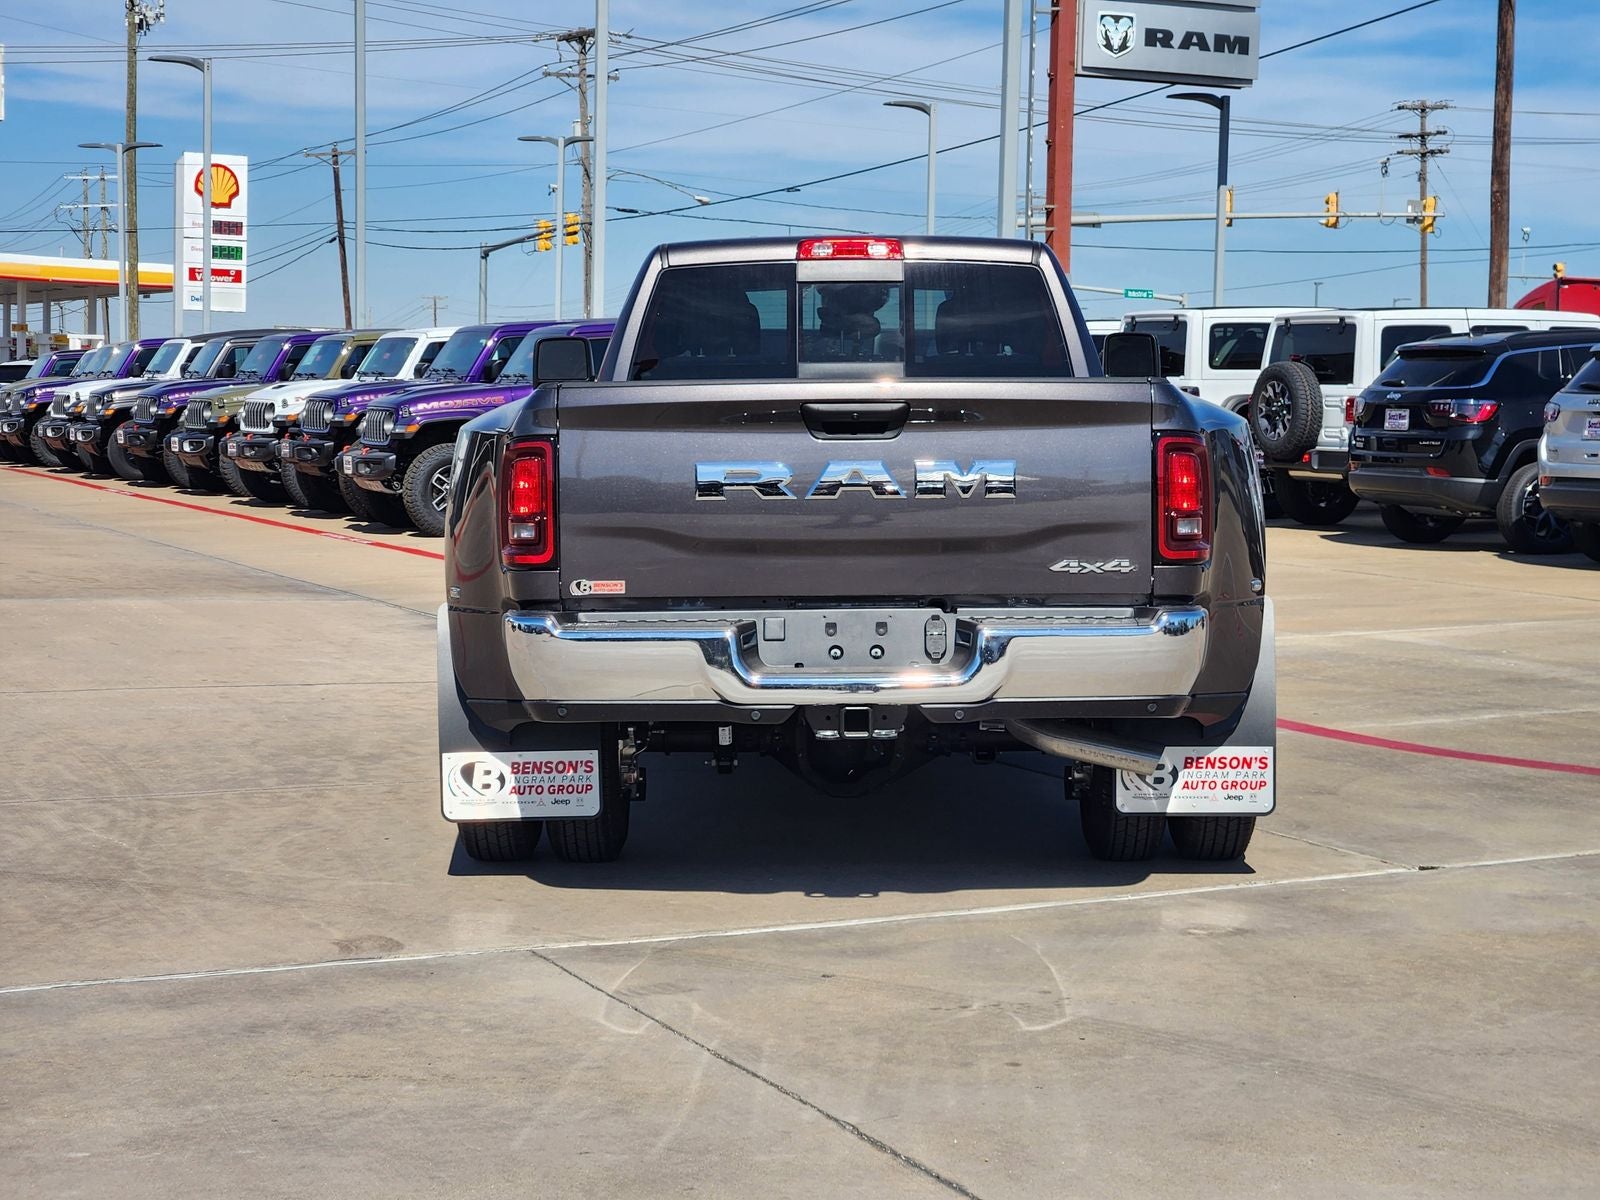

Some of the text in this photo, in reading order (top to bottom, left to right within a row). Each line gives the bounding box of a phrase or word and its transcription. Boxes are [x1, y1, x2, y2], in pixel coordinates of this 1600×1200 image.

[1144, 27, 1250, 56] RAM
[416, 396, 506, 410] MOJAVE
[694, 459, 1017, 501] RAM
[1048, 558, 1136, 574] 4x4
[510, 759, 594, 775] BENSON'S
[1183, 756, 1269, 770] BENSON'S
[509, 774, 593, 784] INGRAM PARK
[1182, 770, 1267, 779] INGRAM PARK
[508, 783, 593, 796] AUTO GROUP
[1181, 780, 1267, 791] AUTO GROUP
[550, 797, 571, 806] Jeep
[1223, 793, 1244, 802] Jeep
